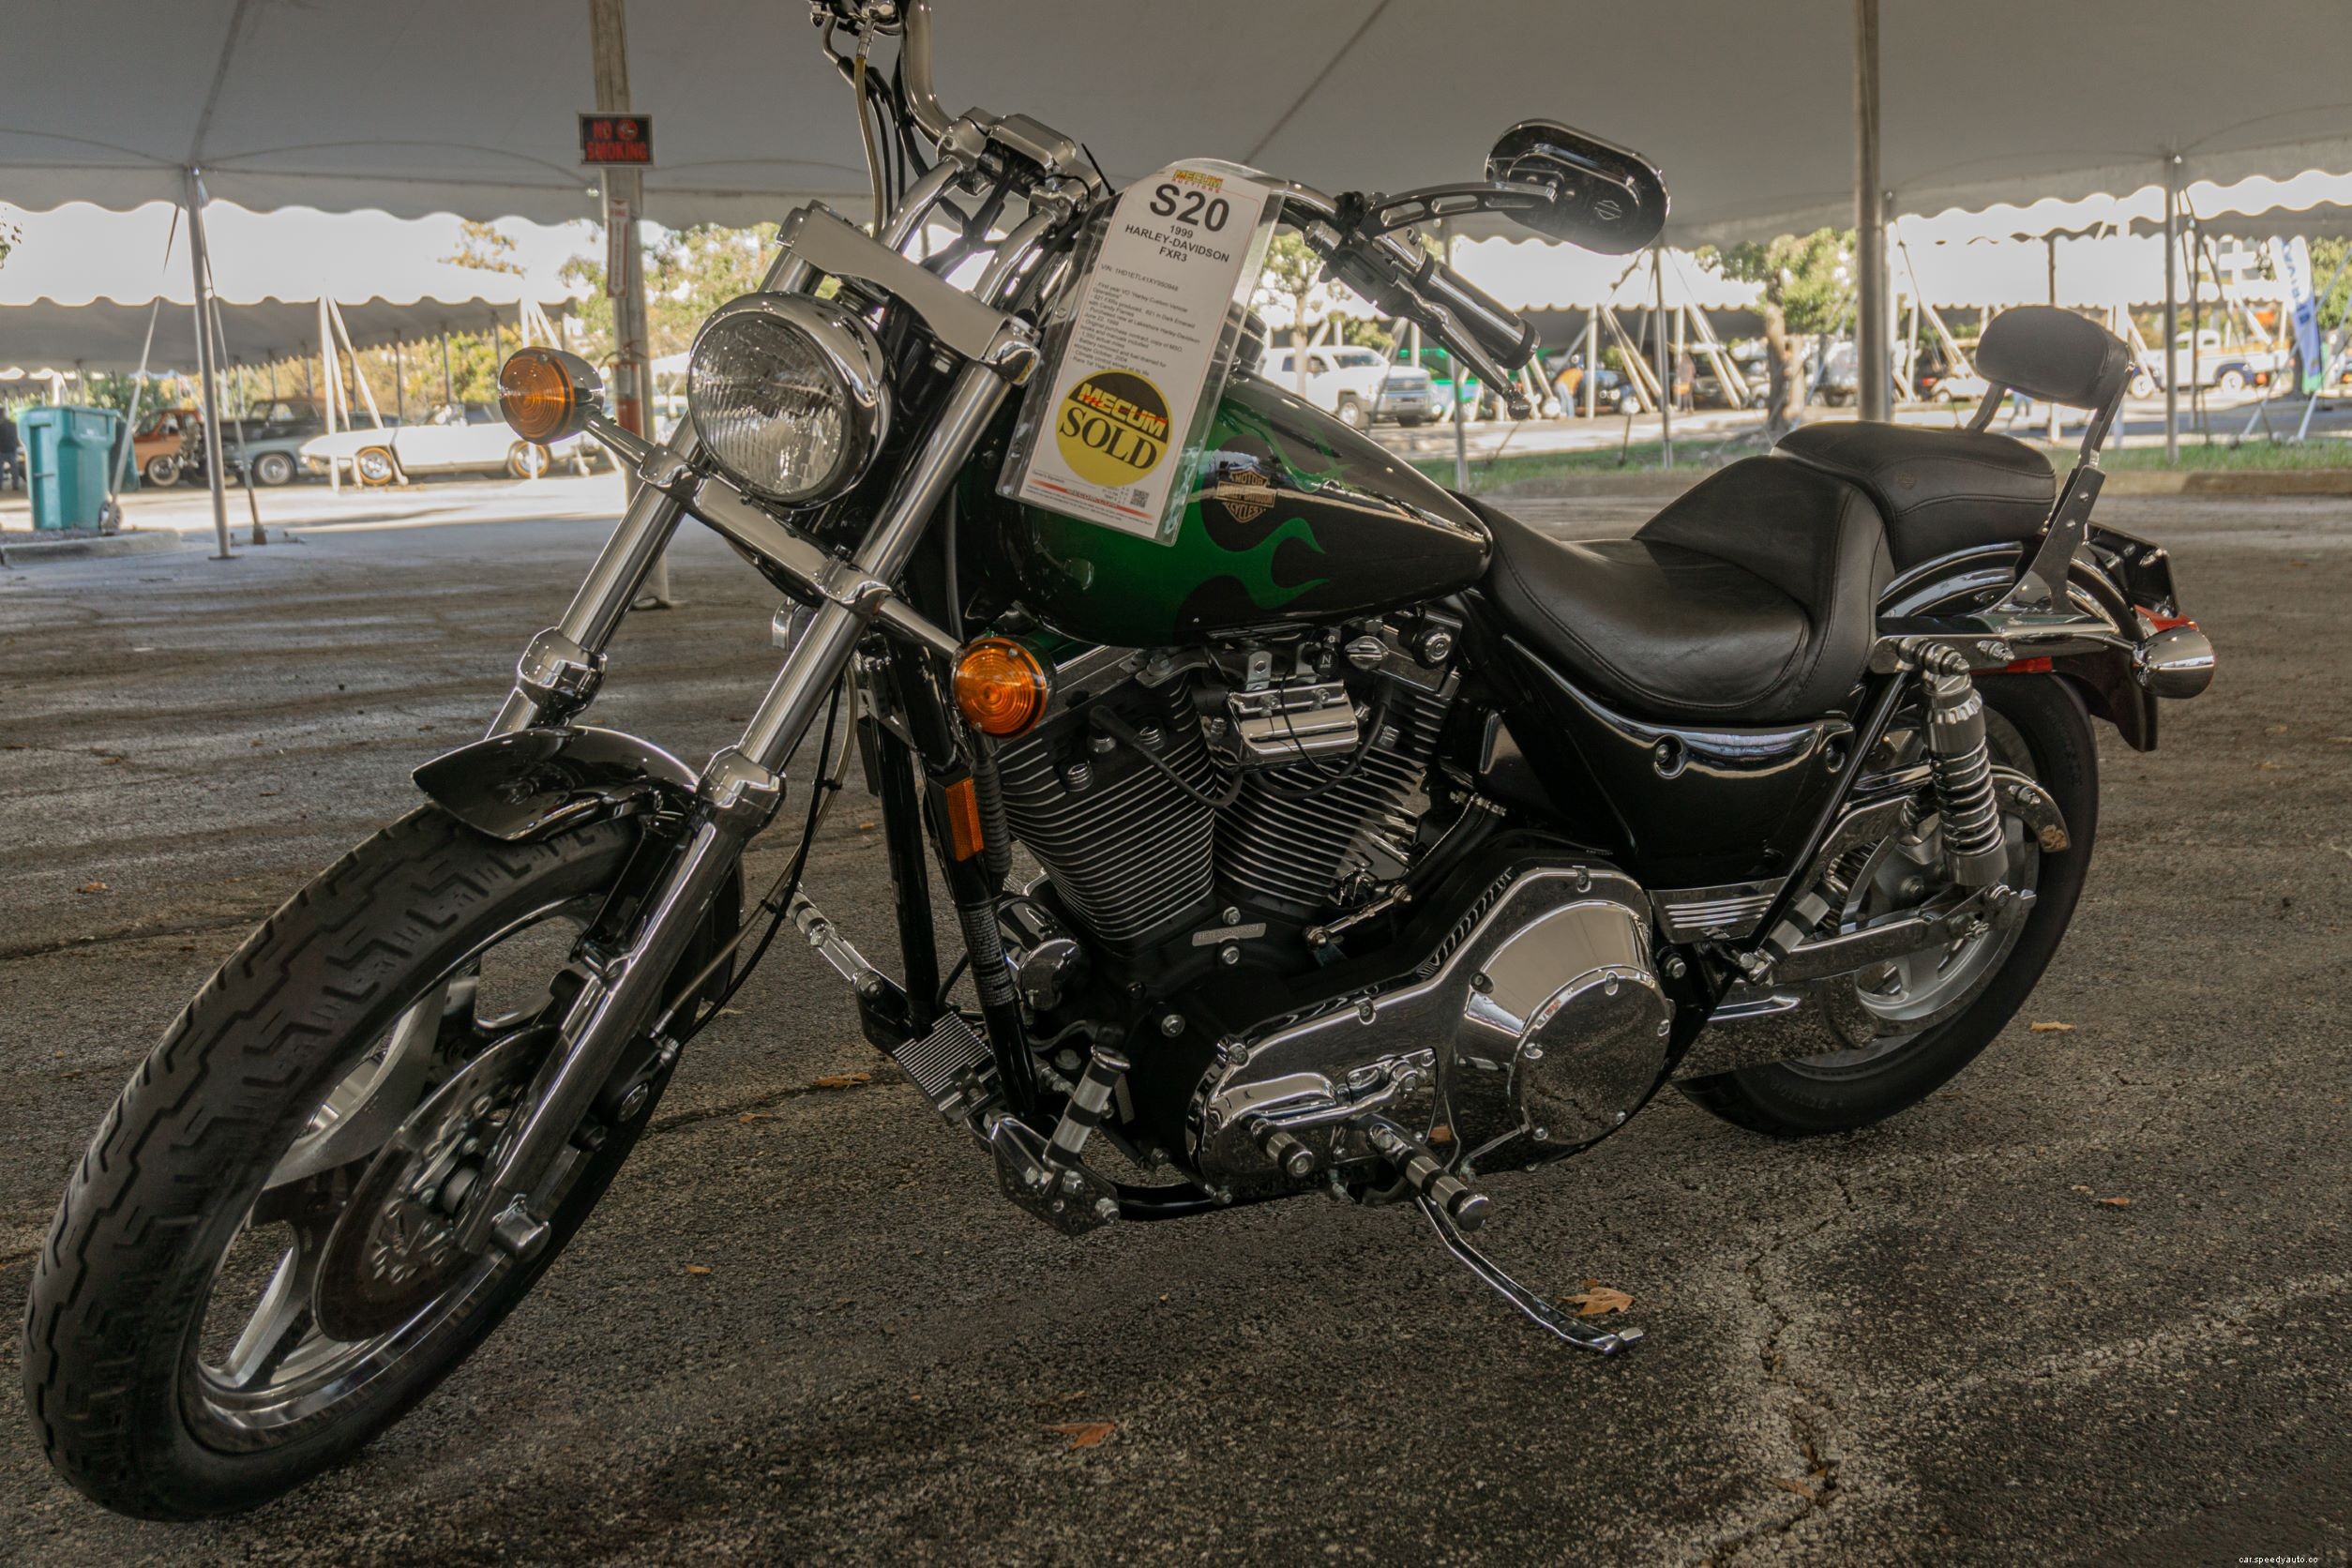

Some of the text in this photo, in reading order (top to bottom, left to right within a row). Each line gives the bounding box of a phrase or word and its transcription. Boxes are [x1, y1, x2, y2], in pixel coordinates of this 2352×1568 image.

[593, 119, 611, 139] NO
[586, 141, 647, 159] SMOKING
[1172, 170, 1223, 188] MECUM
[1150, 183, 1229, 232] S20
[1169, 225, 1194, 239] 1999
[1124, 223, 1230, 263] HARLEY-DAVIDSON
[1159, 246, 1187, 263] FXR3
[1078, 383, 1168, 437] MECUM
[1060, 407, 1157, 469] SOLD
[1234, 474, 1263, 486] MOTOR
[1229, 502, 1259, 519] CYCLES
[1322, 655, 1332, 664] N
